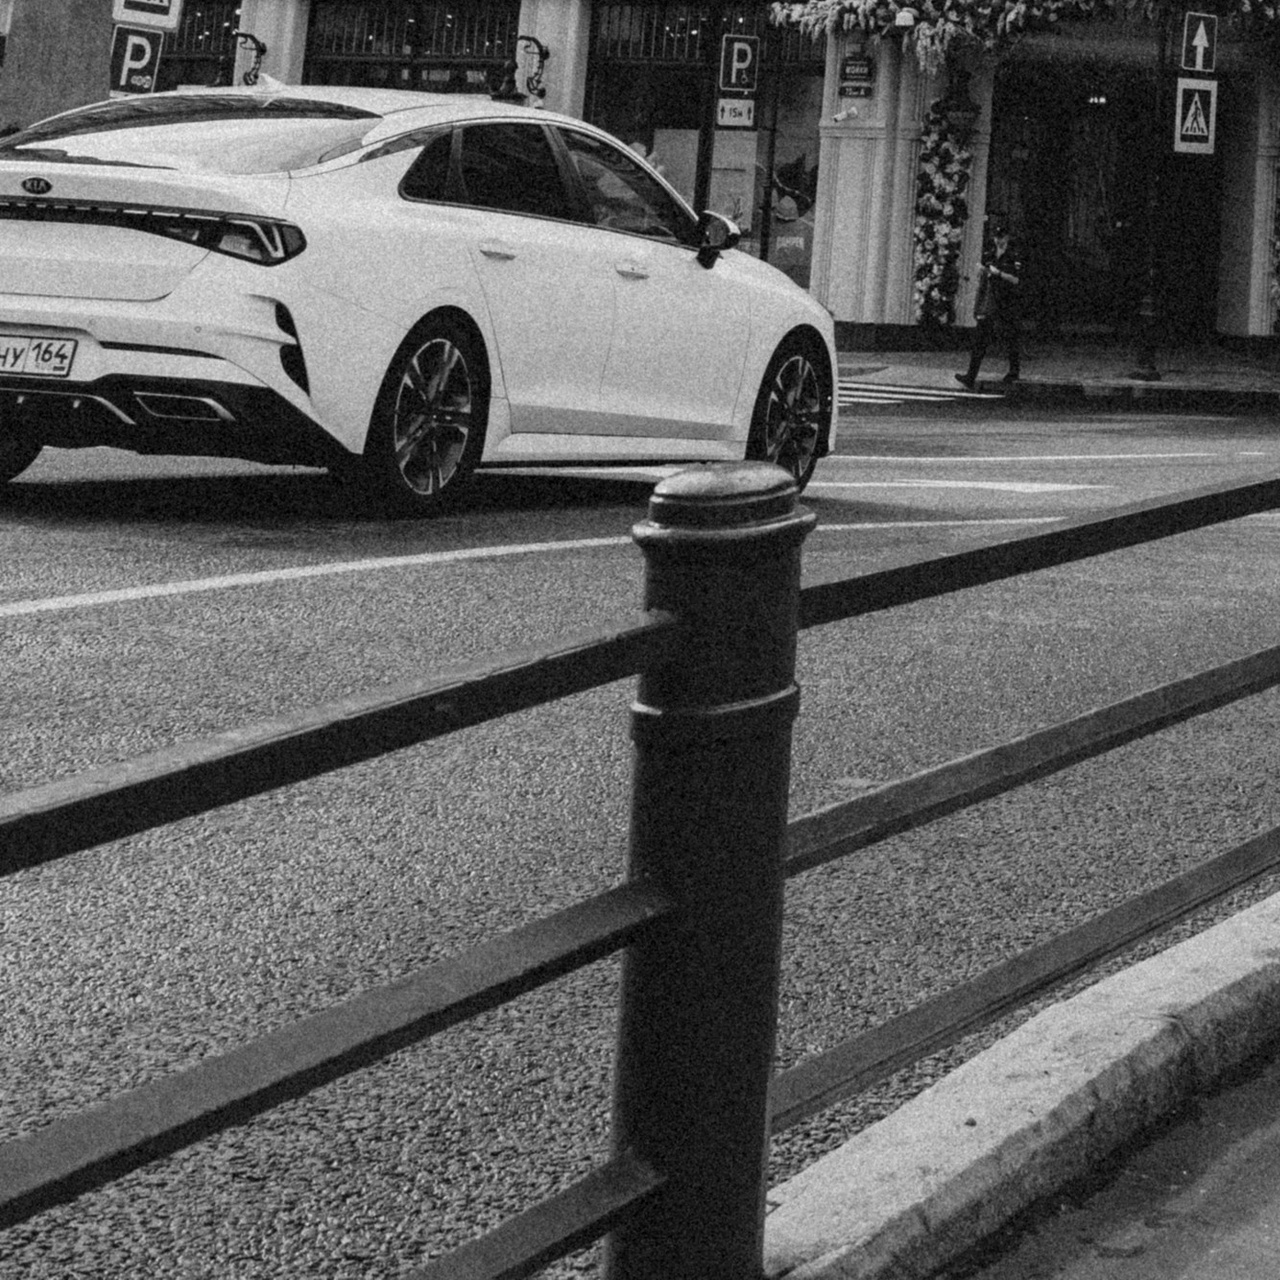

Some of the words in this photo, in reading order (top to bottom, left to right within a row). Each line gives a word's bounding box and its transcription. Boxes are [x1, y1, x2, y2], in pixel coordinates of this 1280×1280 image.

[119, 34, 152, 86] P
[730, 41, 752, 84] P
[24, 179, 49, 192] KIA
[32, 341, 68, 365] 164
